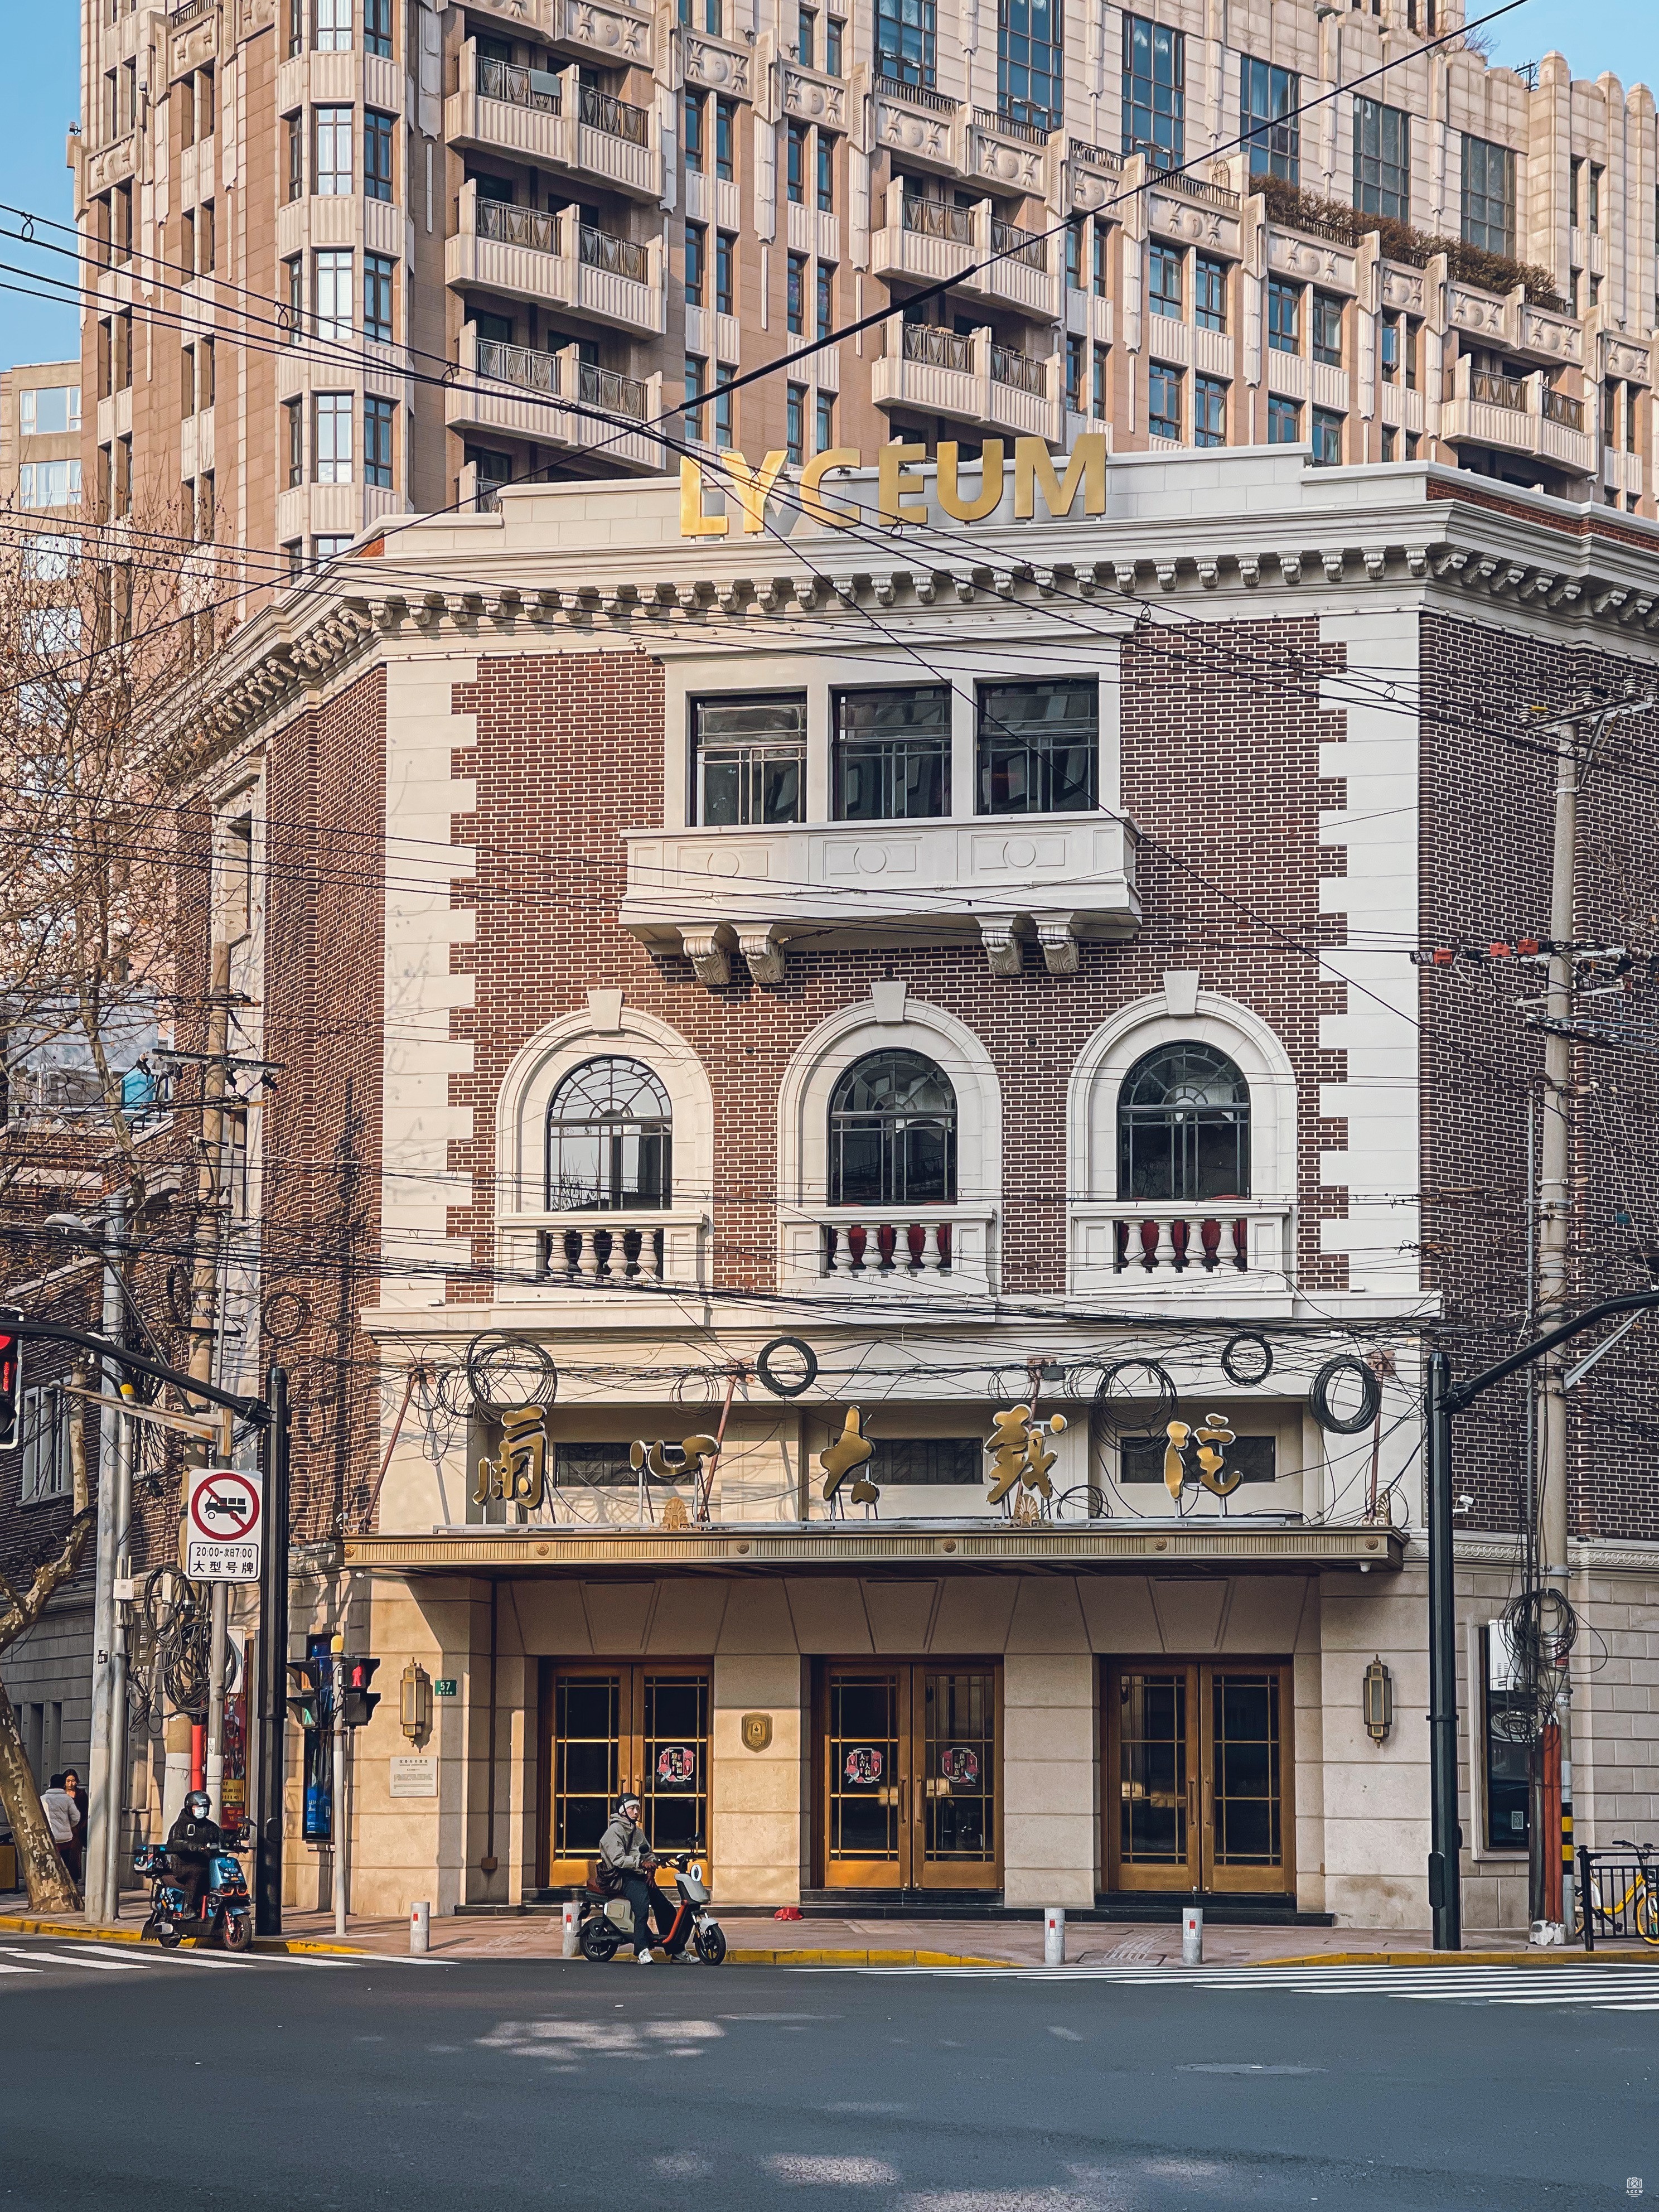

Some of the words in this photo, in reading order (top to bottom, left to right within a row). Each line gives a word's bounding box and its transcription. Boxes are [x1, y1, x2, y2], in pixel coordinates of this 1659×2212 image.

[680, 433, 1107, 537] LYCEUM
[193, 1560, 254, 1575] 大型号牌
[440, 1682, 451, 1691] 57
